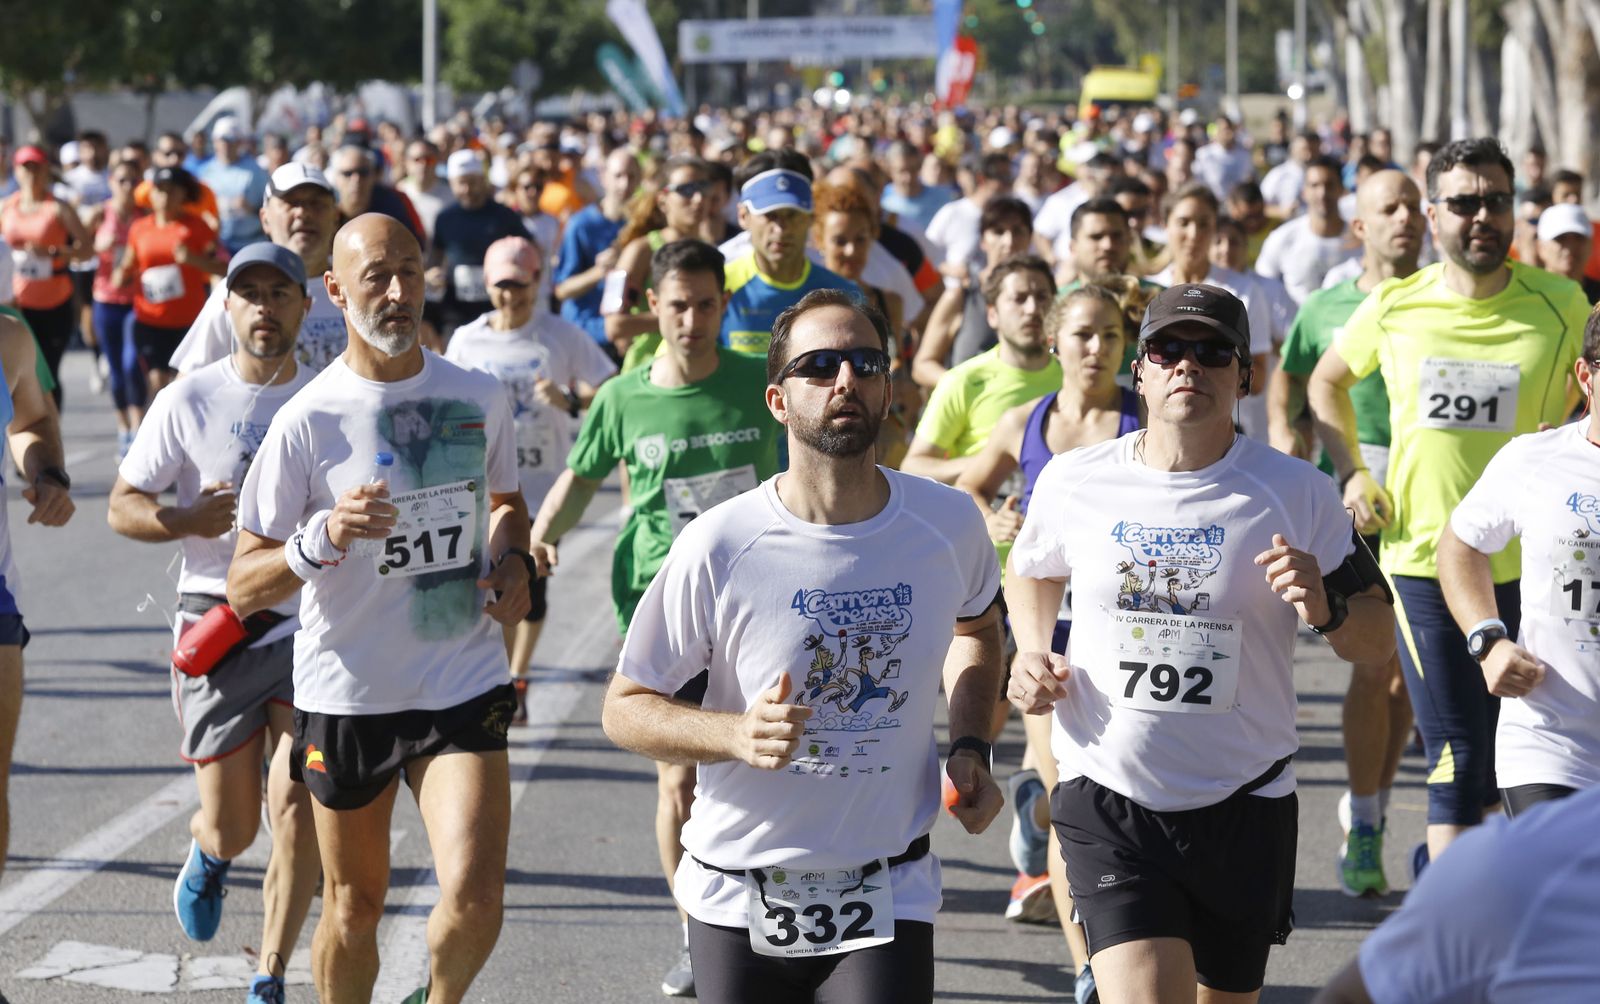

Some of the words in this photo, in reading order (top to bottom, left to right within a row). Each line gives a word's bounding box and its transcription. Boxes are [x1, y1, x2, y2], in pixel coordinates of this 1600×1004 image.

[1428, 393, 1499, 423] 291
[391, 493, 417, 504] RRERA
[417, 491, 428, 500] DE
[429, 489, 439, 498] LA
[1124, 524, 1206, 544] Carrera
[385, 525, 463, 568] 517
[1140, 542, 1212, 558] Prensa
[1567, 540, 1600, 549] CARRER
[805, 589, 896, 613] Carrera
[826, 604, 904, 625] Prensa
[1125, 616, 1168, 626] CARRERA
[1170, 619, 1182, 627] DE
[1184, 621, 1196, 629] LA
[1198, 621, 1234, 631] PRENSA
[1158, 628, 1180, 640] APM
[1119, 660, 1213, 705] 792
[800, 871, 825, 880] APM
[765, 900, 875, 947] 332
[785, 947, 813, 955] HERRERA
